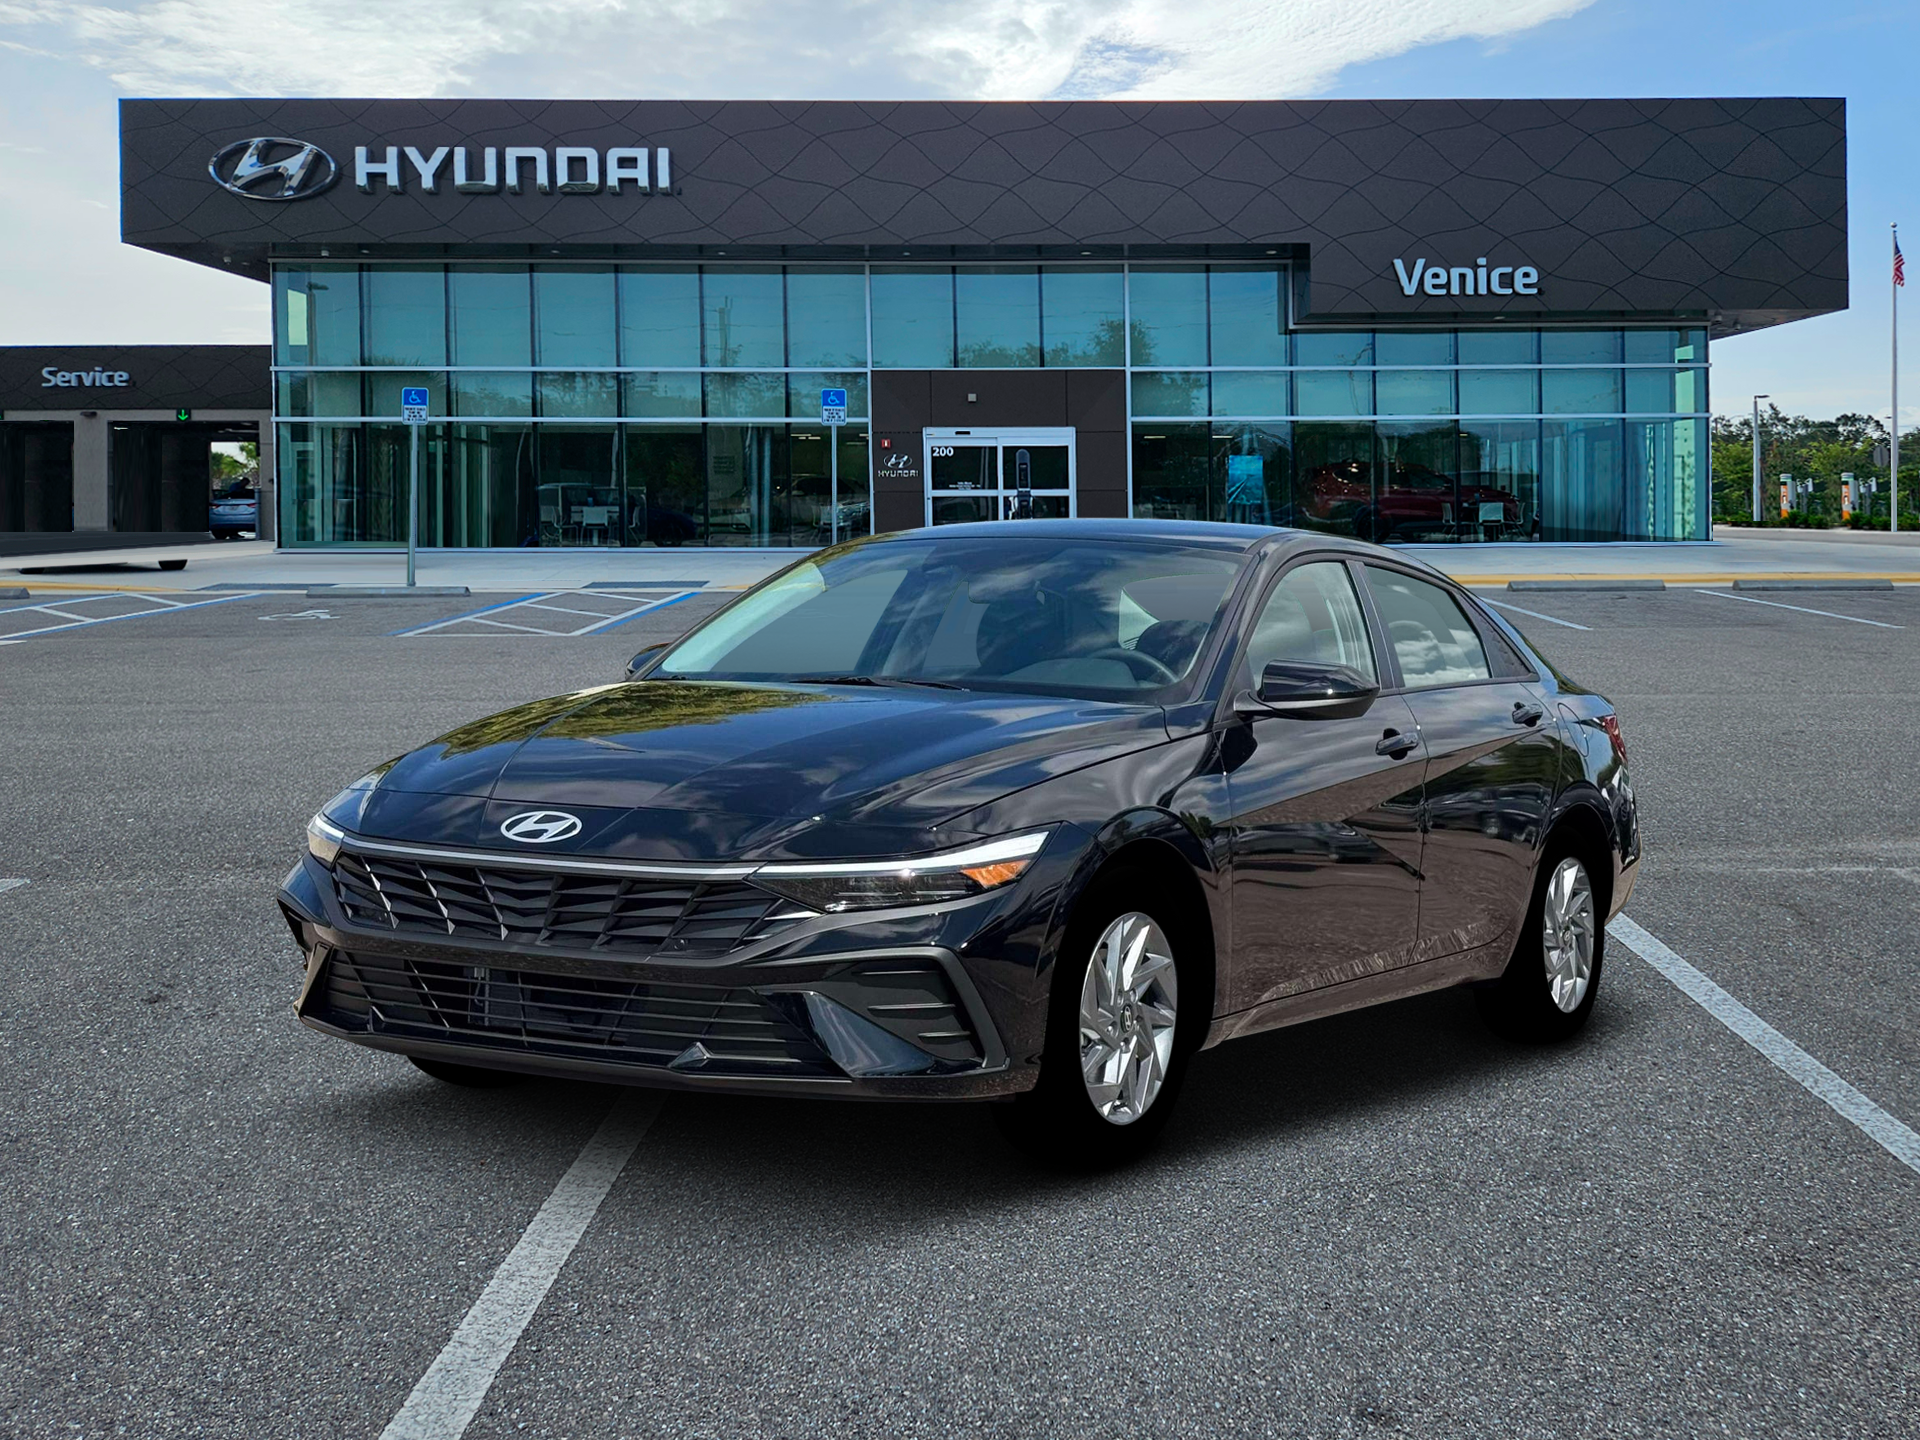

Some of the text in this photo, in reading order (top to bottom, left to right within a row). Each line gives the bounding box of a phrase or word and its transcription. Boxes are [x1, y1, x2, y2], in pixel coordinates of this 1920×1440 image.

[354, 146, 671, 194] HYUNDAI
[1392, 257, 1539, 296] Venice
[41, 366, 130, 387] Service
[932, 446, 954, 457] 200
[877, 470, 919, 478] HYUNDAI
